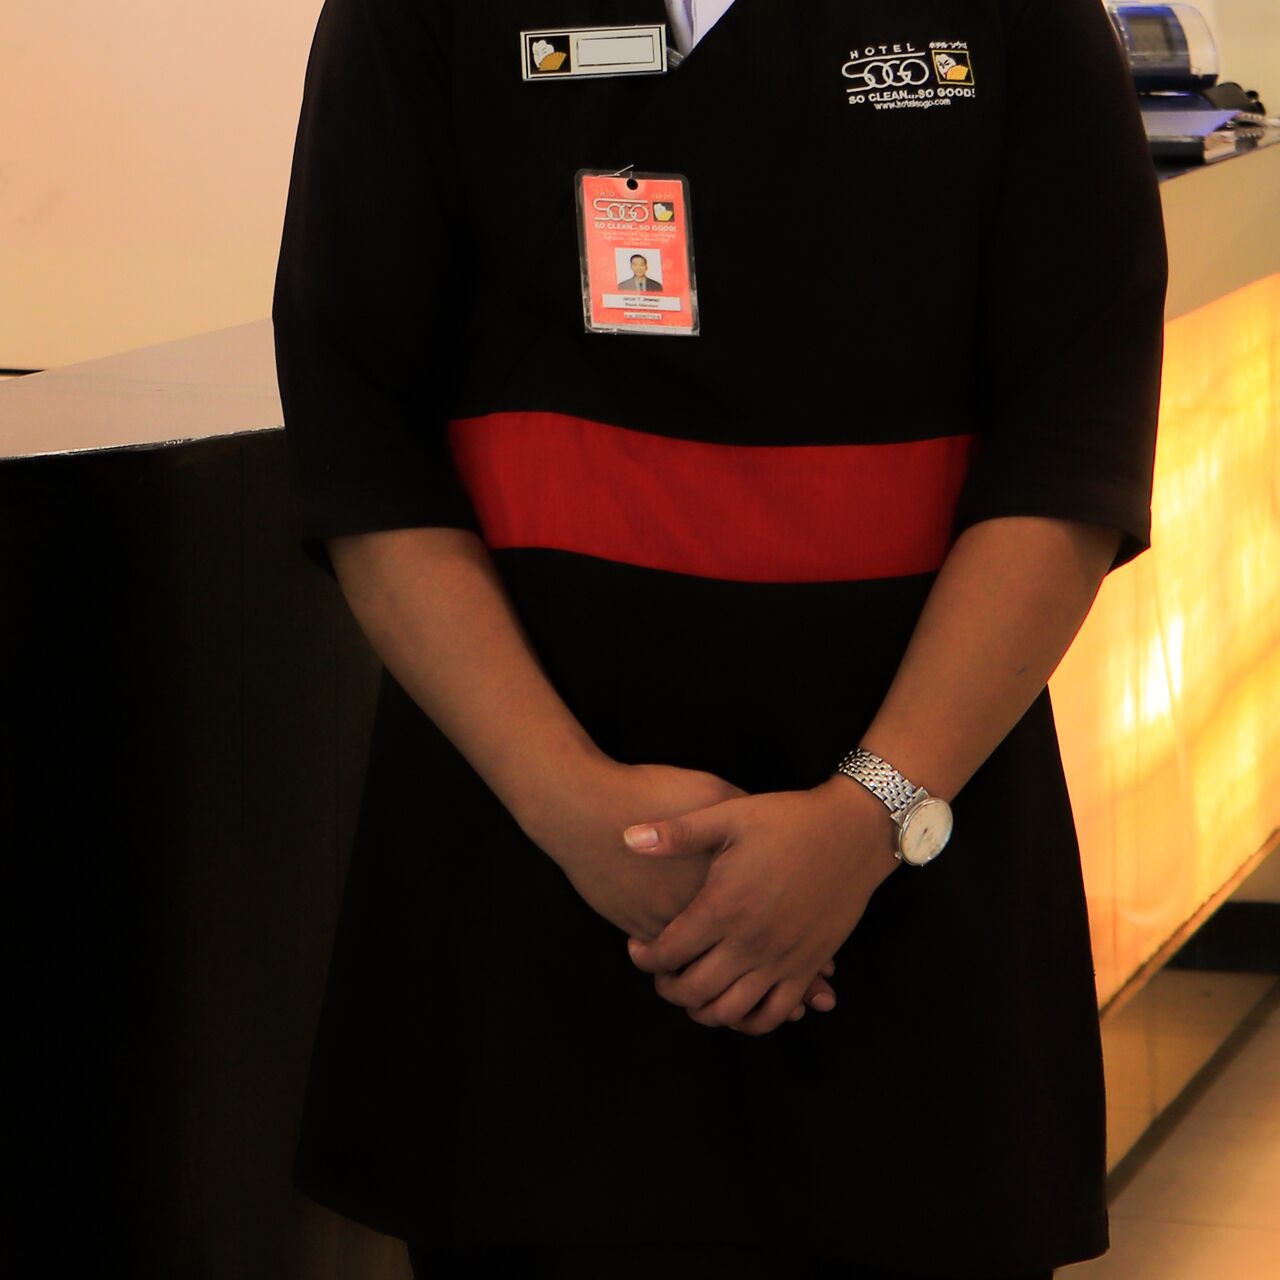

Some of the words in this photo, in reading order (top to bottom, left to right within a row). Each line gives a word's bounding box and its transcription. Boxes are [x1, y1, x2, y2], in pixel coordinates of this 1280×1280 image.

[850, 42, 915, 60] HOTEL
[841, 51, 930, 93] SOGO
[848, 94, 865, 105] SO
[936, 87, 976, 98] GOOD!
[593, 198, 649, 223] SOGO
